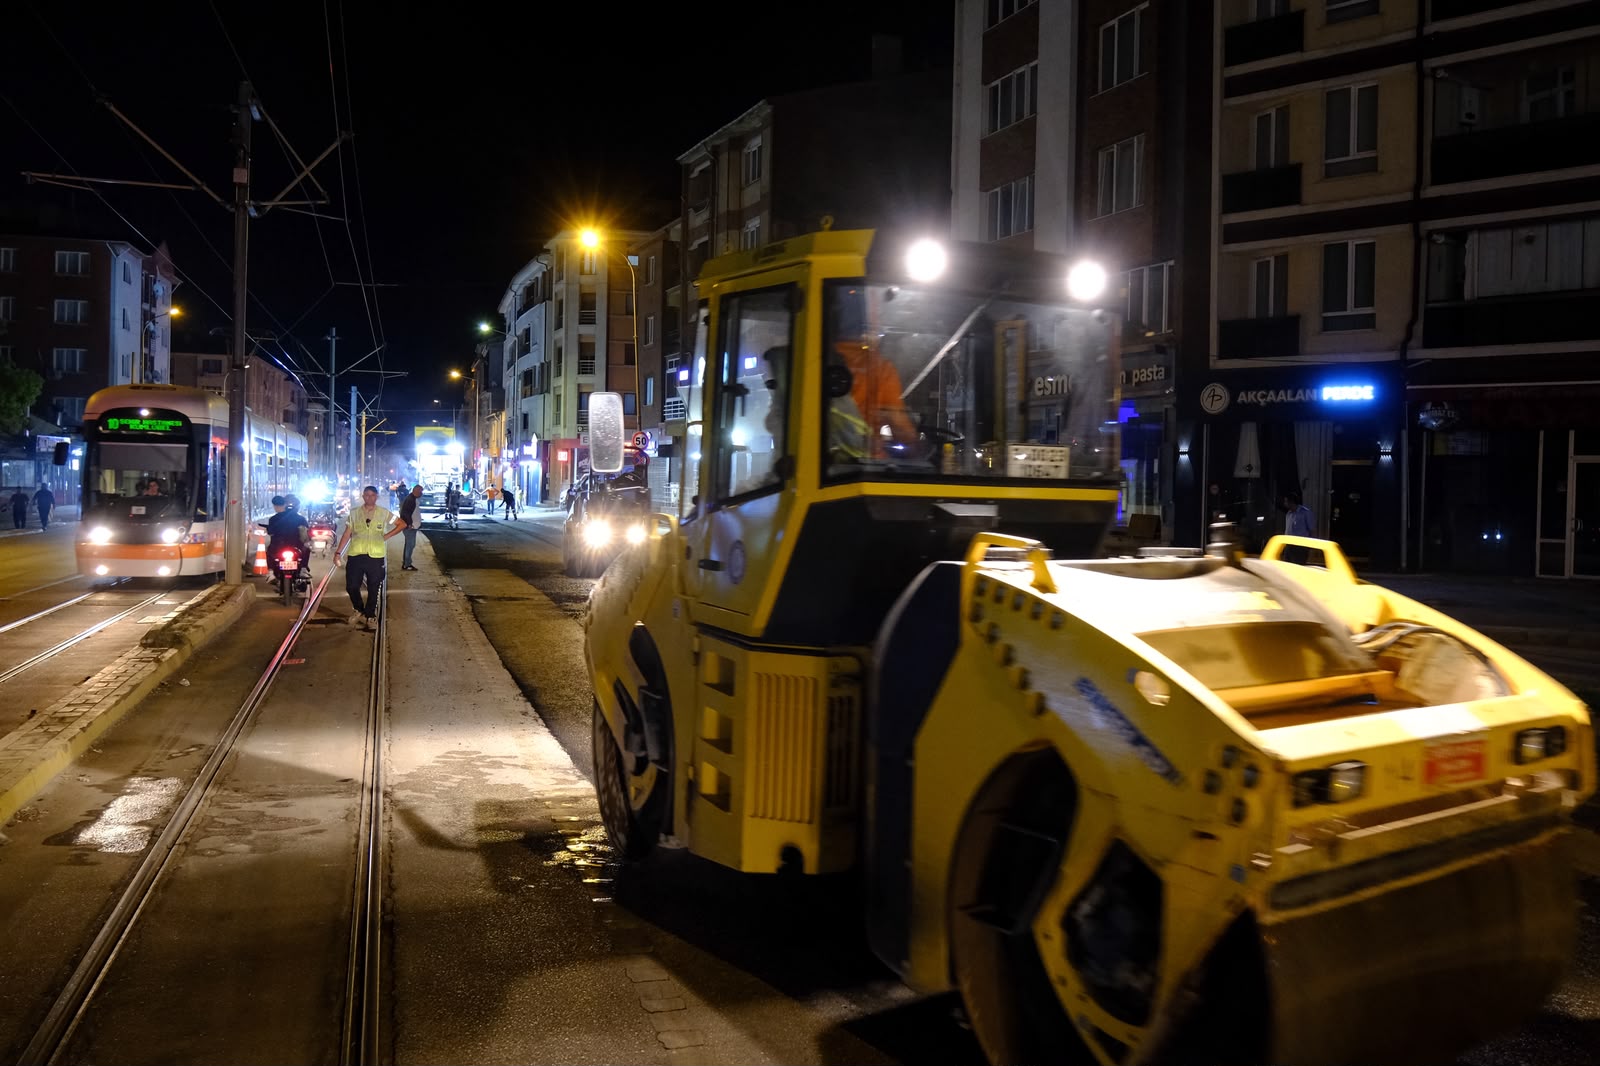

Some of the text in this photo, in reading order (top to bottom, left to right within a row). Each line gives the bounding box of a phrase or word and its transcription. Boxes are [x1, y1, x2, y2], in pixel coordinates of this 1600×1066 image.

[1132, 364, 1165, 386] pasta
[1237, 388, 1317, 406] AKÇAALAN
[107, 418, 119, 429] 10
[635, 437, 647, 446] 50
